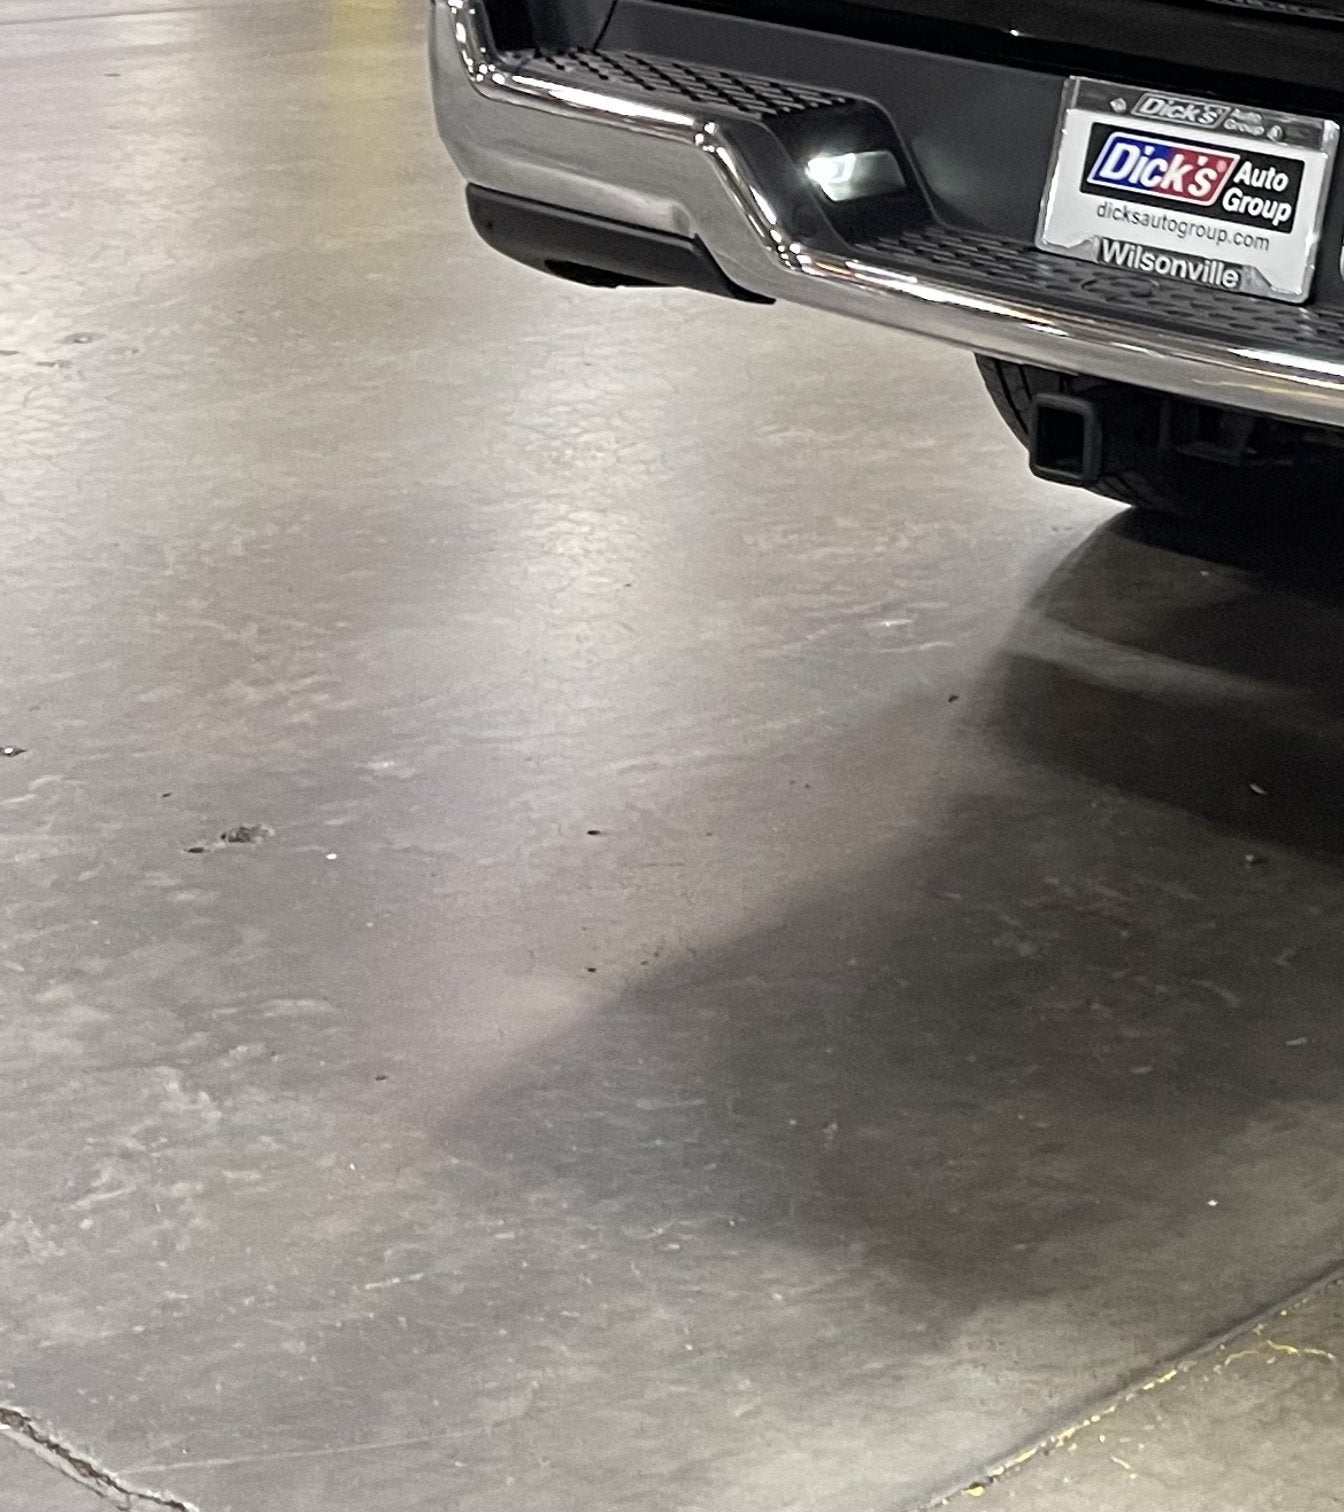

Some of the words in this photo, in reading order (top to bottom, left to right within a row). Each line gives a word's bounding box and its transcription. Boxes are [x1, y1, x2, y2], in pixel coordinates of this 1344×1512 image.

[1098, 141, 1219, 198] Dick's
[1233, 160, 1290, 193] Auto
[1096, 200, 1271, 252] dicksautogroup.com
[1222, 187, 1293, 226] Group
[1101, 237, 1241, 288] Wilsonville
